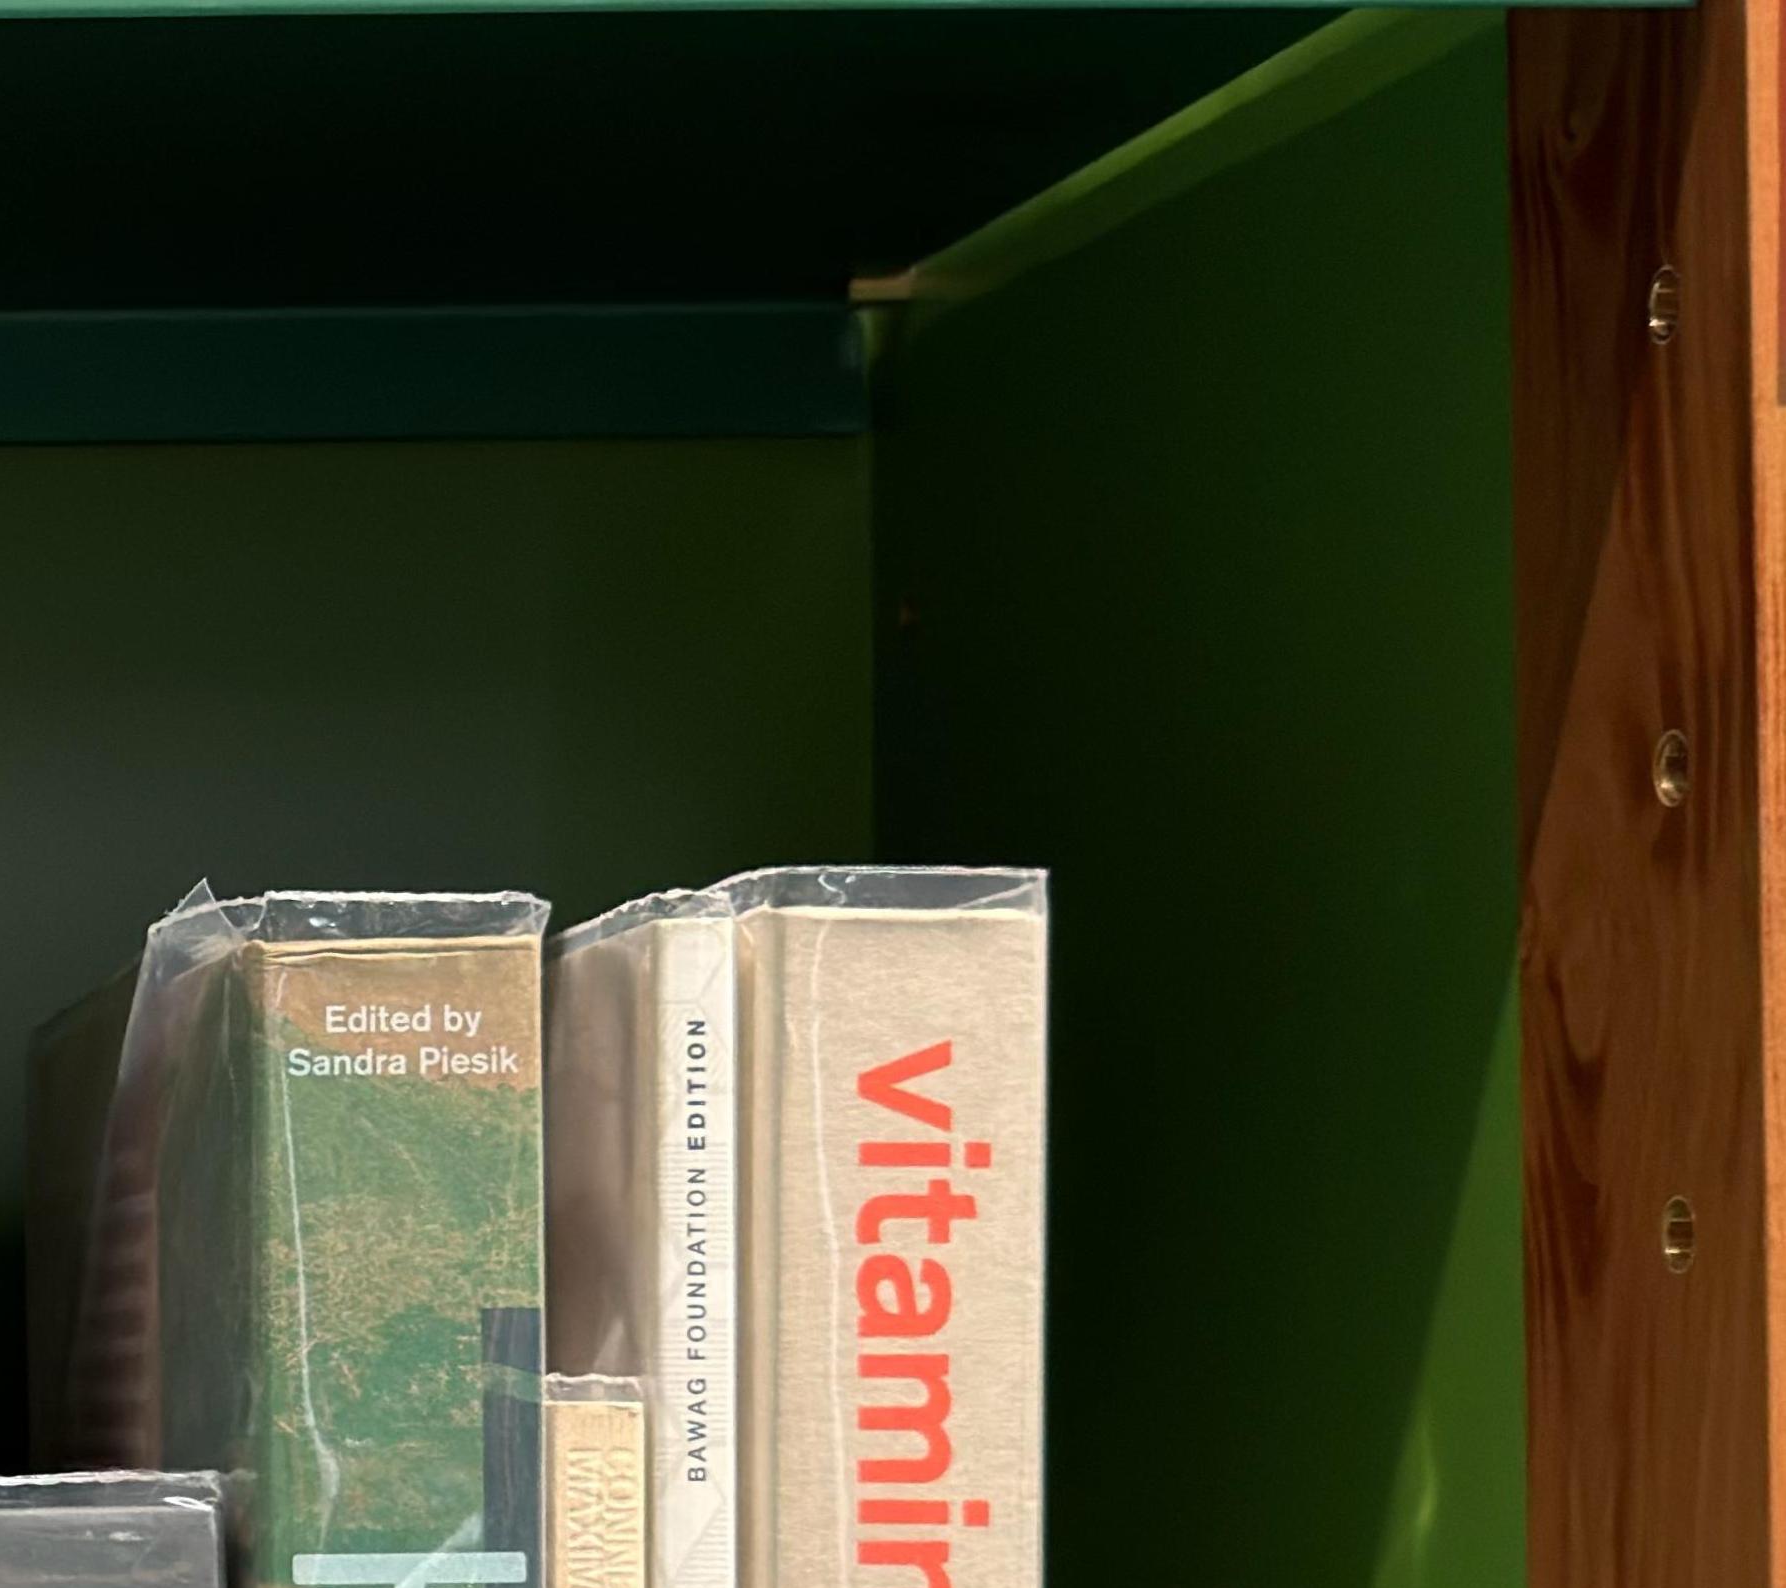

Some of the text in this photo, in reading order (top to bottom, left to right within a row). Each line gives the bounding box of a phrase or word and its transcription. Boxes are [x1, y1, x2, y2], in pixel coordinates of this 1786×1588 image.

[324, 1004, 483, 1040] Edited by
[287, 1045, 520, 1078] Sandra Piesik
[687, 1019, 707, 1483] BAWAG FOUNDATION EDITION
